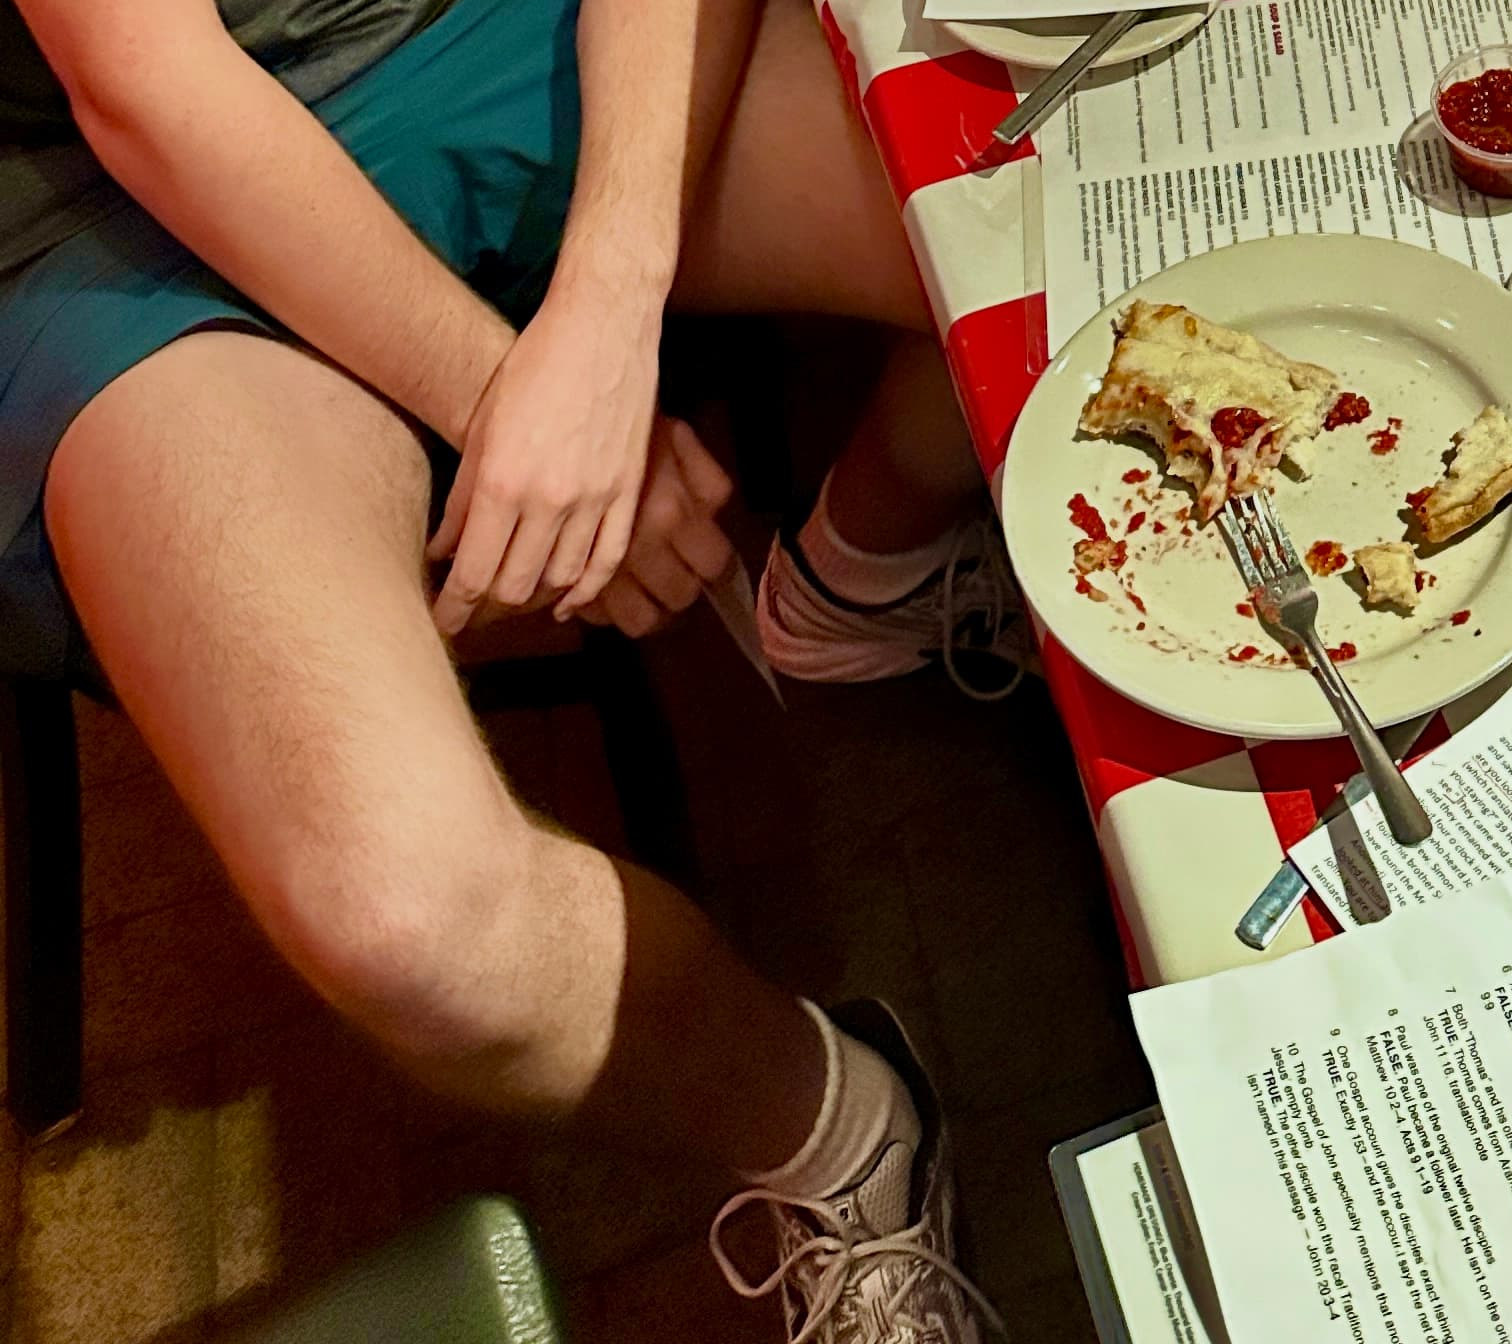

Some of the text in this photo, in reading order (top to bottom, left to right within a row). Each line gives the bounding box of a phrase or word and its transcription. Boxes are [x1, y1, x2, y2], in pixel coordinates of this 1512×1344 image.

[1268, 2, 1280, 23] SOUP
[1273, 31, 1285, 55] SALAD
[1487, 745, 1504, 761] and
[1449, 770, 1466, 786] you
[1495, 820, 1508, 833] 39
[1276, 1108, 1293, 1131] The
[1379, 1030, 1454, 1203] FALSE. Paul became a follower
[1246, 1073, 1306, 1221] isn't named in this passage
[1284, 1132, 1302, 1159] other
[1394, 1025, 1496, 1265] Paul was one of the original twelve disciples
[1293, 1060, 1393, 1318] The Gospel of John specifically mentions that
[1295, 1162, 1318, 1204] disciple
[1336, 1045, 1351, 1069] One
[1345, 1071, 1369, 1113] Gospel
[1360, 1114, 1385, 1159] account
[1375, 1160, 1397, 1190] gives
[1390, 1191, 1404, 1210] the
[1419, 1269, 1440, 1303] exact
[1312, 1206, 1327, 1232] won
[1321, 1233, 1335, 1255] the
[1328, 1257, 1348, 1290] race!
